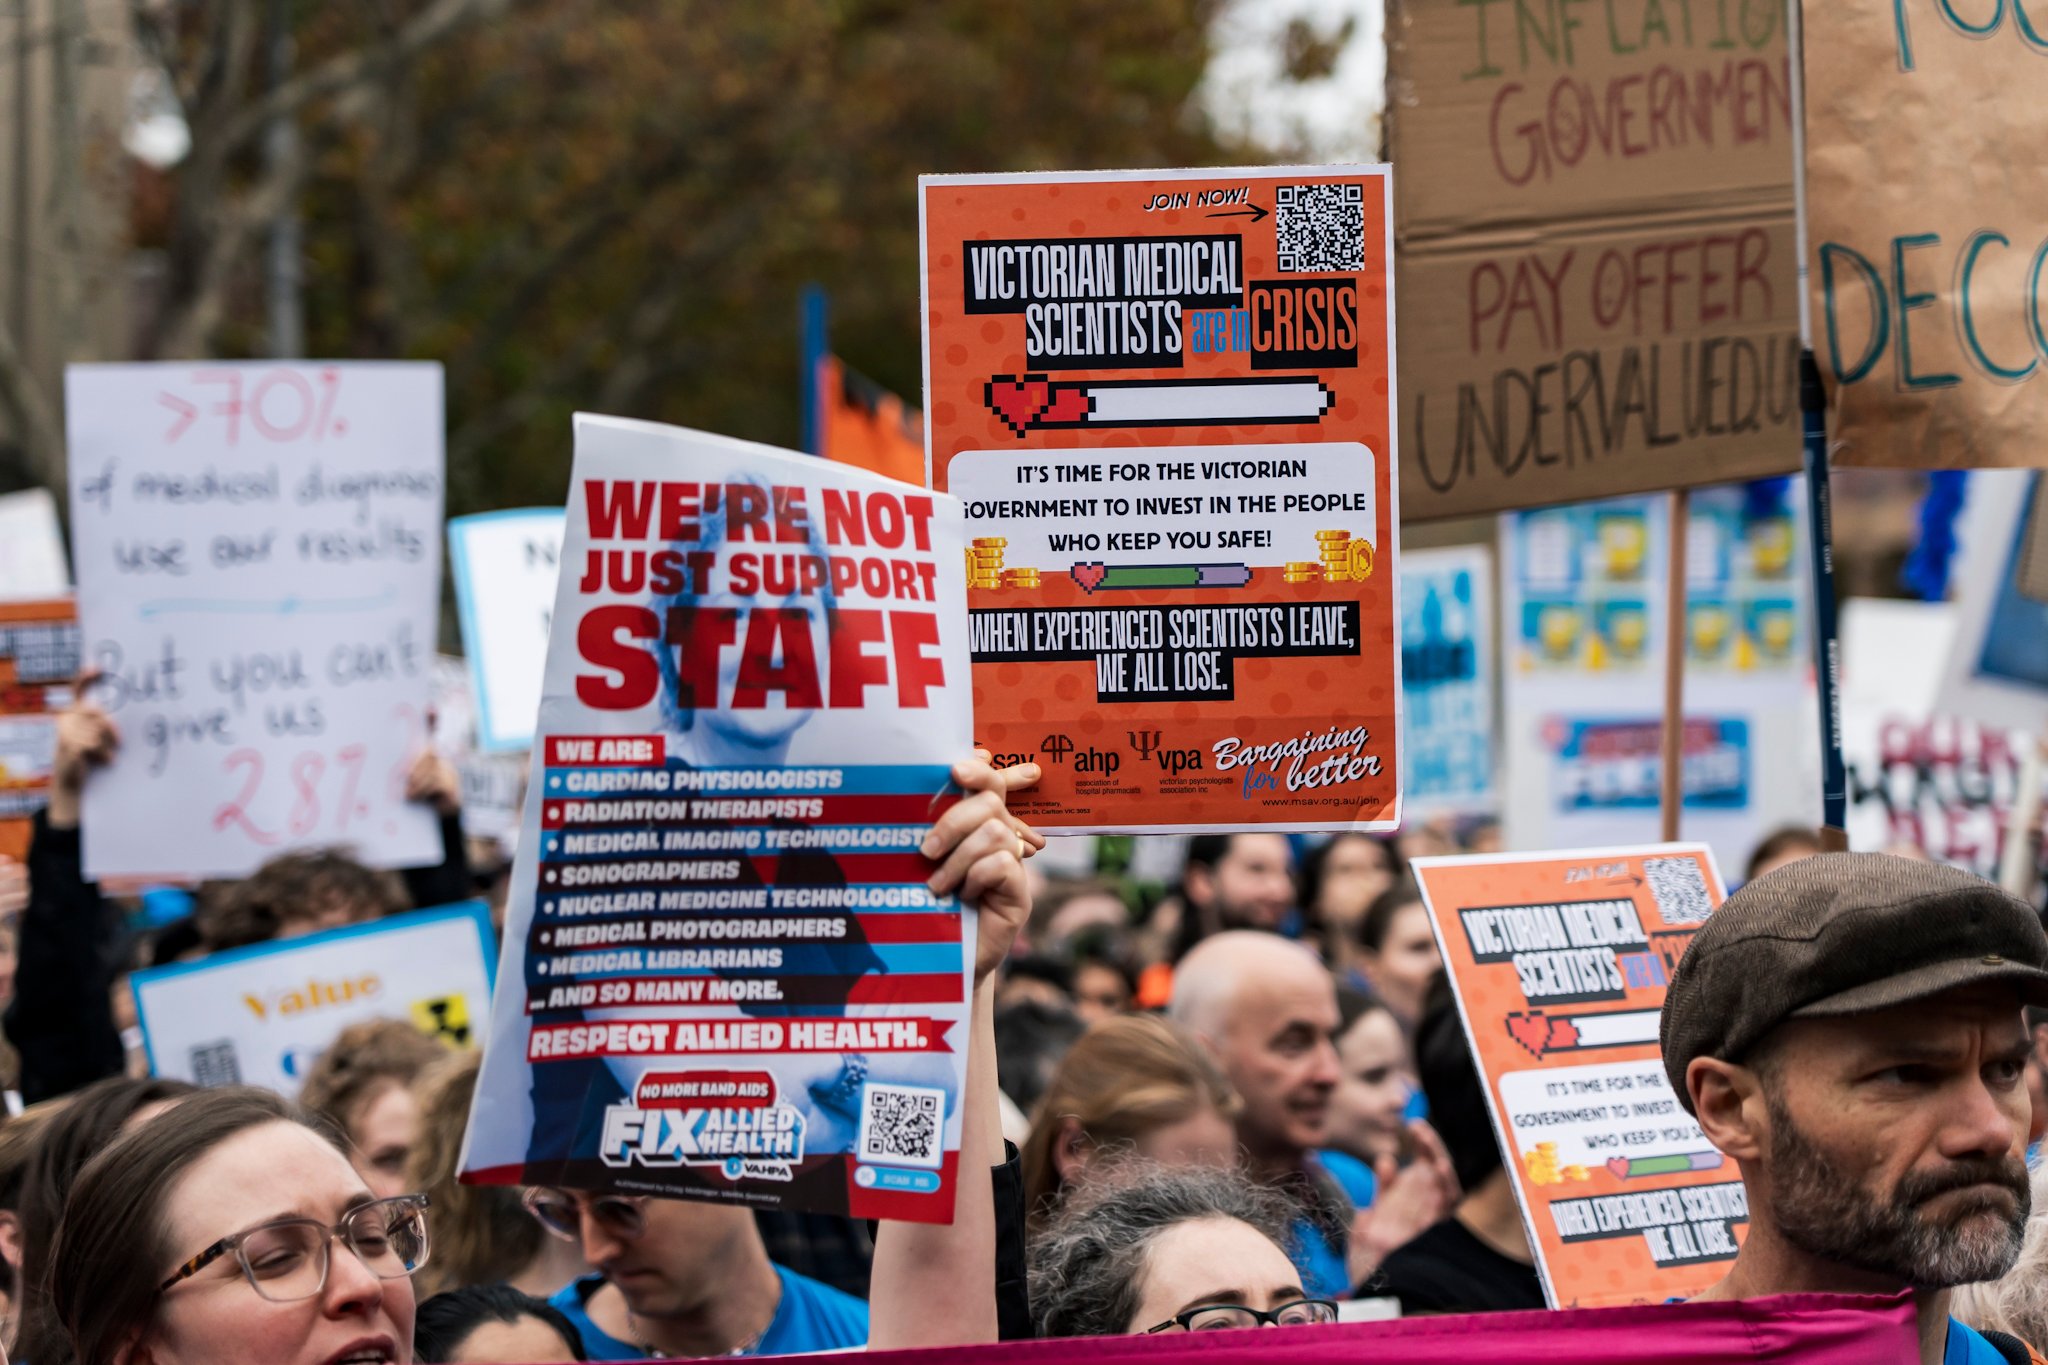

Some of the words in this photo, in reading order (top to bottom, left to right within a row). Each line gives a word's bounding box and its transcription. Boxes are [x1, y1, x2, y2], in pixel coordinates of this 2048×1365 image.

[1460, 0, 1790, 80] INFLATIO
[1490, 58, 1793, 186] GOVERNMEN
[1143, 193, 1190, 211] JOIN
[1196, 187, 1250, 207] NOW!
[971, 242, 1116, 300] VICTORIAN
[1124, 240, 1243, 296] MEDICAL
[1468, 247, 1575, 357] PAY
[1592, 226, 1774, 335] OFFER
[1026, 300, 1182, 356] SCIENTISTS
[1192, 308, 1227, 354] are
[1231, 305, 1251, 352] in
[1252, 287, 1357, 352] CRISIS
[132, 463, 280, 504] medical
[1016, 464, 1050, 484] IT'S
[1055, 463, 1102, 482] TIME
[1109, 462, 1150, 481] FOR
[1156, 461, 1195, 480] THE
[1201, 460, 1307, 480] VICTORIAN
[584, 479, 810, 543] WE'RE
[821, 489, 933, 551] NOT
[1103, 498, 1129, 516] TO
[1136, 496, 1204, 515] INVEST
[1210, 496, 1232, 514] IN
[1237, 494, 1277, 514] THE
[1283, 493, 1366, 513] PEOPLE
[294, 513, 425, 563] results
[1048, 533, 1101, 552] WHO
[1107, 532, 1160, 551] KEEP
[1166, 531, 1211, 550] YOU
[1217, 529, 1272, 549] SAFE!
[580, 550, 715, 596] JUST
[729, 552, 936, 602] SUPPORT
[969, 611, 1028, 653] WHEN
[1033, 610, 1163, 652] EXPERIENCED
[1169, 607, 1284, 648] SCIENTISTS
[1289, 604, 1354, 649] LEAVE,
[575, 605, 945, 711] STAFF
[1097, 653, 1128, 693] WE
[1134, 651, 1168, 692] ALL
[1174, 650, 1228, 691] LOSE.
[92, 636, 188, 710] But
[209, 650, 311, 712] you
[144, 705, 234, 776] give
[264, 698, 326, 737] us
[1212, 726, 1369, 771] Bargaining
[556, 742, 593, 763] WE
[598, 740, 654, 762] ARE:
[989, 753, 1035, 770] sav
[1074, 747, 1119, 777] ahp
[1157, 749, 1202, 775] vpa
[566, 771, 669, 793] CARDIAC
[673, 769, 843, 792] PHYSIOLOGISTS
[1075, 779, 1110, 787] association
[1113, 778, 1119, 786] of
[1159, 777, 1187, 785] victorian
[1189, 776, 1234, 786] psychologists
[1160, 786, 1196, 794] association
[1198, 785, 1209, 793] inc
[1243, 765, 1280, 800] for
[1286, 752, 1382, 792] better
[1075, 787, 1101, 796] hospital
[1103, 787, 1141, 796] pharmacists
[1262, 796, 1380, 807] www.msav.org.au/join
[564, 800, 687, 823] RADIATION
[690, 798, 824, 820] THERAPISTS
[565, 832, 660, 854] MEDICAL
[664, 831, 762, 853] IMAGING
[765, 826, 929, 850] TECHNOLOGIST
[561, 861, 740, 887] SONOGRAPHERS
[559, 893, 655, 917] NUCLEAR
[659, 891, 768, 913] MEDICINE
[554, 923, 647, 947] MEDICAL
[651, 918, 848, 942] PHOTOGRAPHERS
[1461, 905, 1569, 955] VICTORIAN
[1560, 899, 1649, 948] MEDICAL
[550, 953, 643, 976] MEDICAL
[647, 949, 784, 971] LIBRARIANS
[1512, 947, 1625, 997] SCIENTISTS
[549, 984, 598, 1008] AND
[602, 983, 630, 1006] SO
[634, 981, 706, 1004] MANY
[709, 980, 784, 1001] MORE.
[529, 1023, 670, 1059] RESPECT
[674, 1022, 784, 1051] ALLIED
[789, 1021, 928, 1050] HEALTH.
[640, 1083, 661, 1098] NO
[661, 1083, 699, 1098] MORE
[700, 1082, 737, 1097] BAND
[737, 1082, 769, 1098] AIDS
[1545, 1082, 1568, 1097] IT'S
[1572, 1079, 1601, 1095] TIME
[1607, 1076, 1632, 1092] FOR
[1635, 1073, 1662, 1089] THE
[703, 1107, 796, 1132] ALLIED
[1514, 1107, 1608, 1128] GOVERNMENT
[1611, 1104, 1630, 1118] TO
[1633, 1100, 1677, 1116] INVEST
[603, 1107, 708, 1156] FIX
[702, 1131, 794, 1155] HEALTH
[1583, 1134, 1619, 1149] WHO
[1623, 1130, 1658, 1146] KEEP
[1662, 1126, 1690, 1141] YOU
[744, 1163, 789, 1177] VAHPA
[1549, 1198, 1600, 1237] WHEN
[1593, 1189, 1686, 1232] EXPERIENCED
[1679, 1182, 1750, 1222] SCIENTIST
[1643, 1226, 1675, 1262] WE
[1669, 1223, 1701, 1259] ALL
[1693, 1220, 1739, 1256] LOSE.
